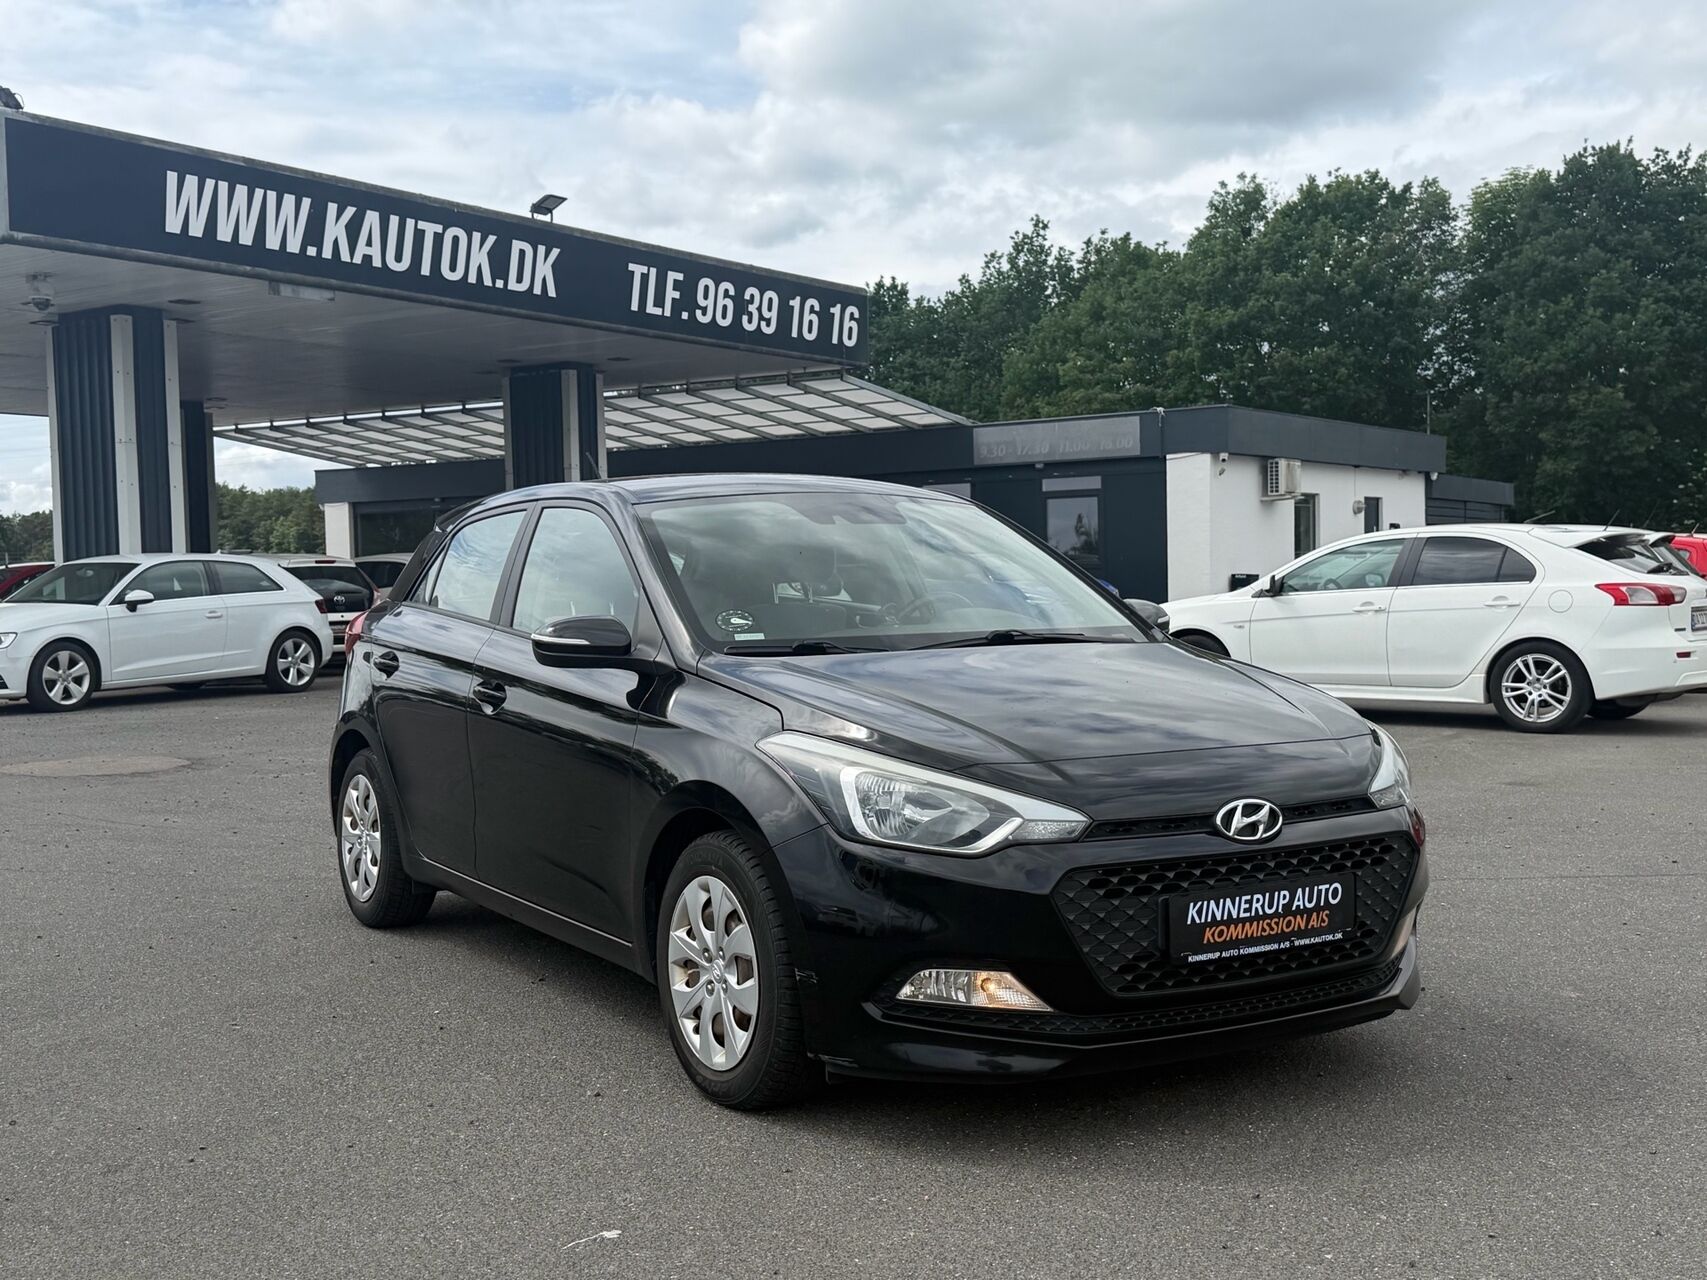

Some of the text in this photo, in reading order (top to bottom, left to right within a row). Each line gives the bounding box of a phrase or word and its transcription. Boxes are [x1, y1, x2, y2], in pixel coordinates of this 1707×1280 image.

[165, 170, 860, 348] WWW.KAUTOK.DK TLF. 96 39 16 16
[1187, 882, 1342, 925] KINNERUP AUTO
[1203, 910, 1330, 944] KOMMISSION A/S
[1188, 951, 1220, 963] KINNERUP
[1221, 948, 1239, 958] AUTO
[1239, 943, 1279, 955] KOMMISSION
[1280, 941, 1290, 949] A/S
[1293, 932, 1343, 947] WWW.KAUTOK.DK
